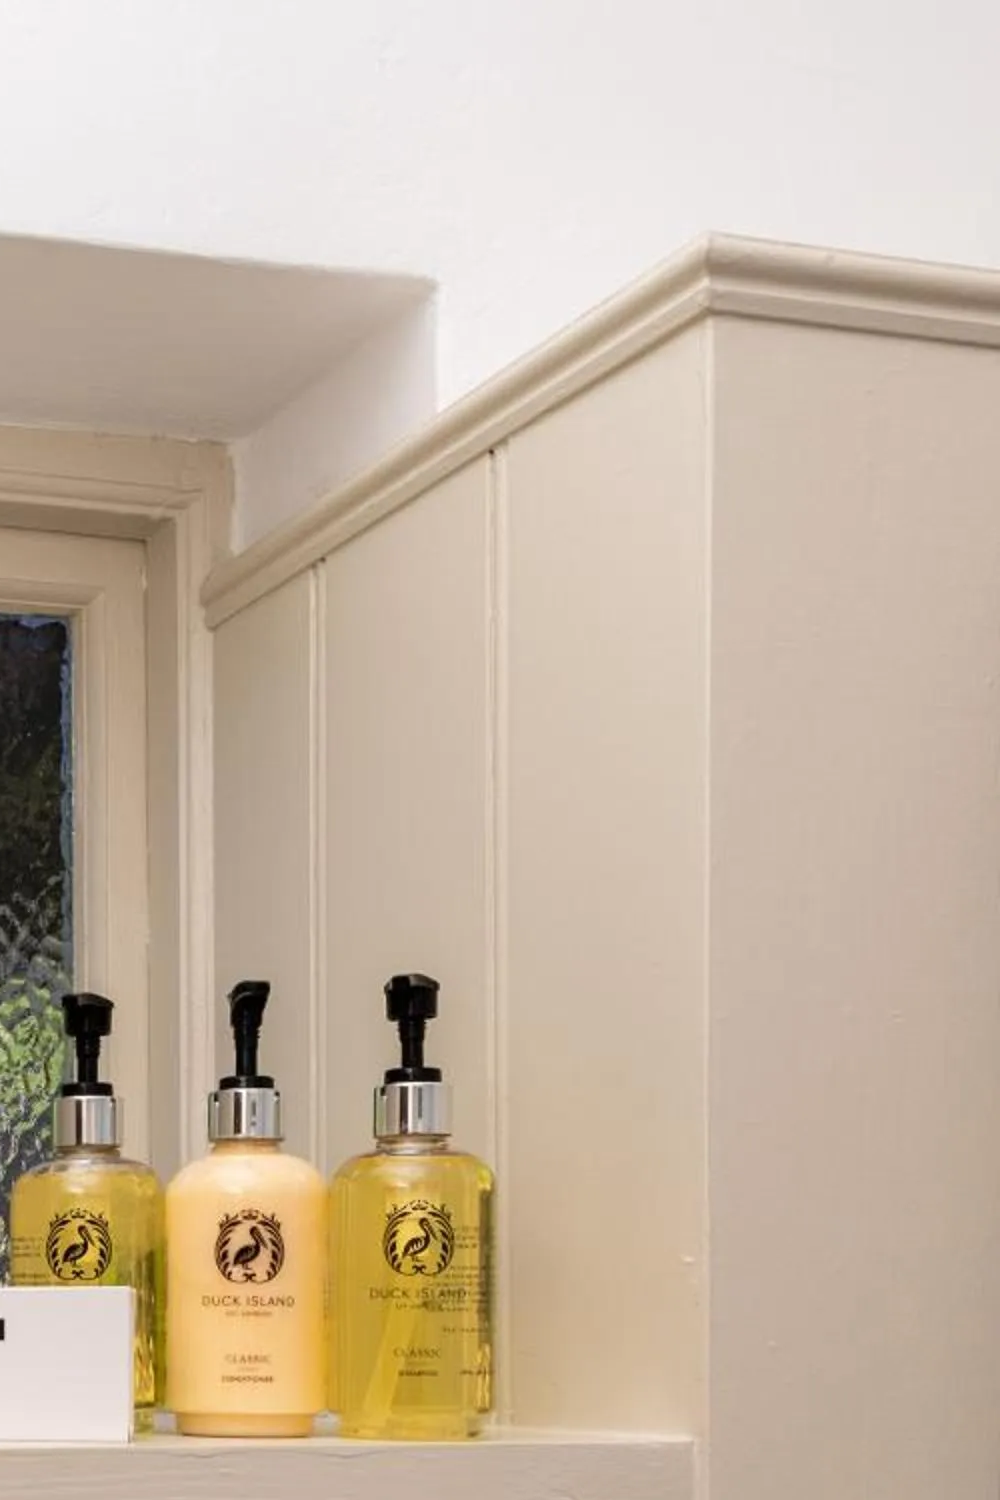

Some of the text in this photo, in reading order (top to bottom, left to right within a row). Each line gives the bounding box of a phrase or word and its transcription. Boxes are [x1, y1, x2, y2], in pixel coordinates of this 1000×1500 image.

[368, 1287, 467, 1299] DUCK ISLAND
[201, 1295, 296, 1307] DUCK ISLAND
